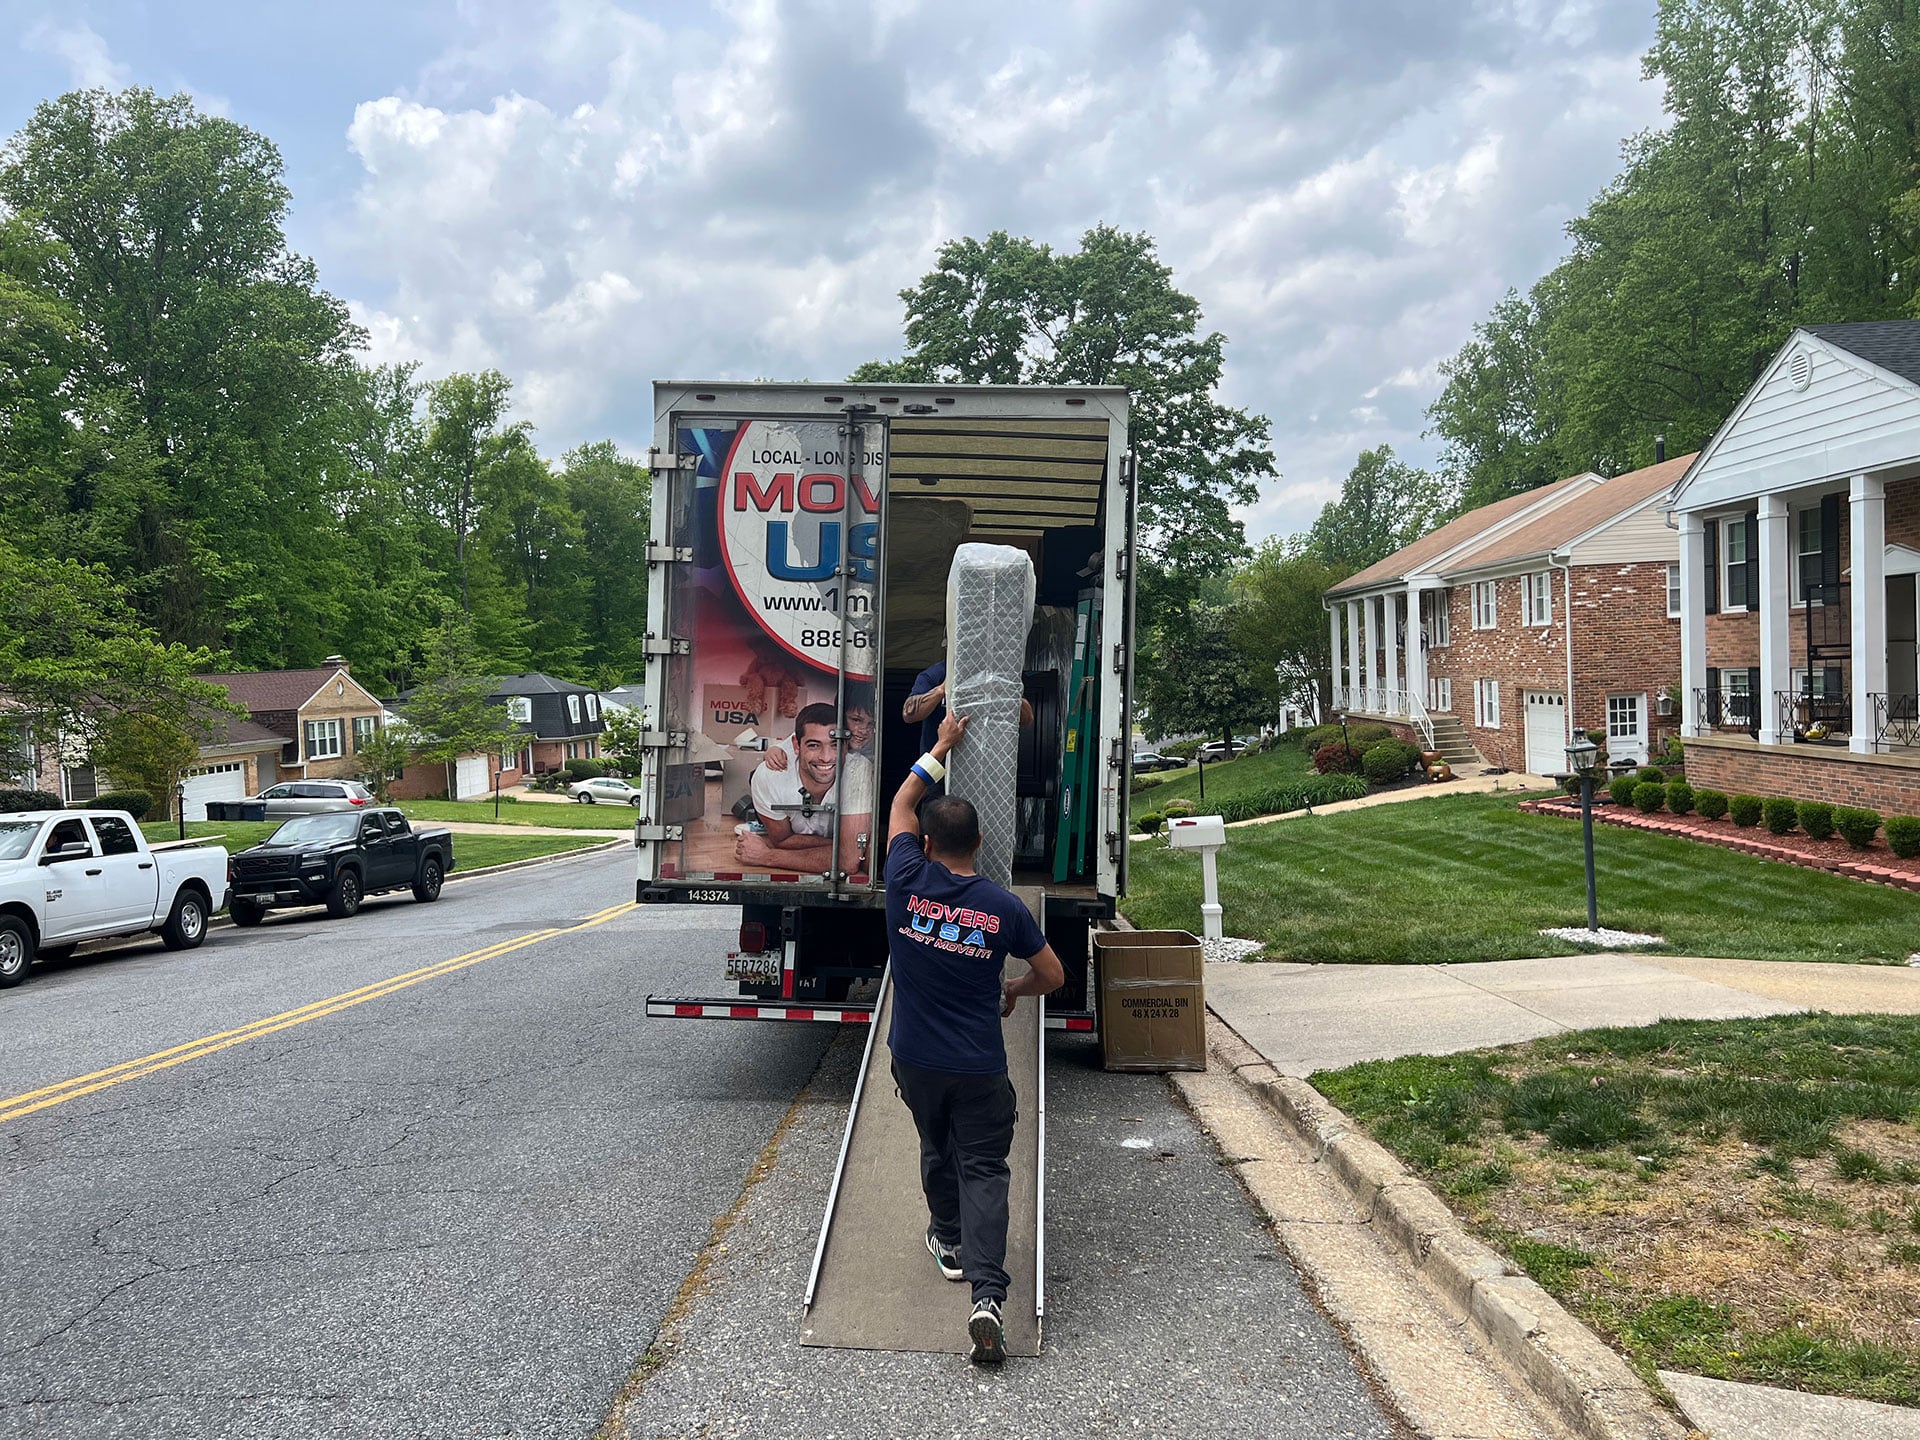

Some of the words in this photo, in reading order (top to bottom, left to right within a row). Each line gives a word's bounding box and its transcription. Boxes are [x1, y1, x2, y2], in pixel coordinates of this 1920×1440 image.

[752, 450, 802, 464] LOCAL
[710, 700, 768, 712] MOVES
[715, 711, 759, 726] USA
[688, 889, 730, 901] 143374
[907, 895, 1000, 934] MOVERS
[899, 926, 935, 945] JUST
[933, 938, 975, 957] MOVE
[974, 948, 993, 959] IT!
[727, 959, 777, 976] 5ER7286
[1122, 998, 1173, 1008] COMMERCIAL
[1175, 998, 1189, 1007] BIN
[1132, 1009, 1142, 1018] 48
[1144, 1009, 1150, 1018] X
[1151, 1009, 1160, 1018] 24
[1162, 1009, 1168, 1018] X
[1169, 1009, 1179, 1018] 28
